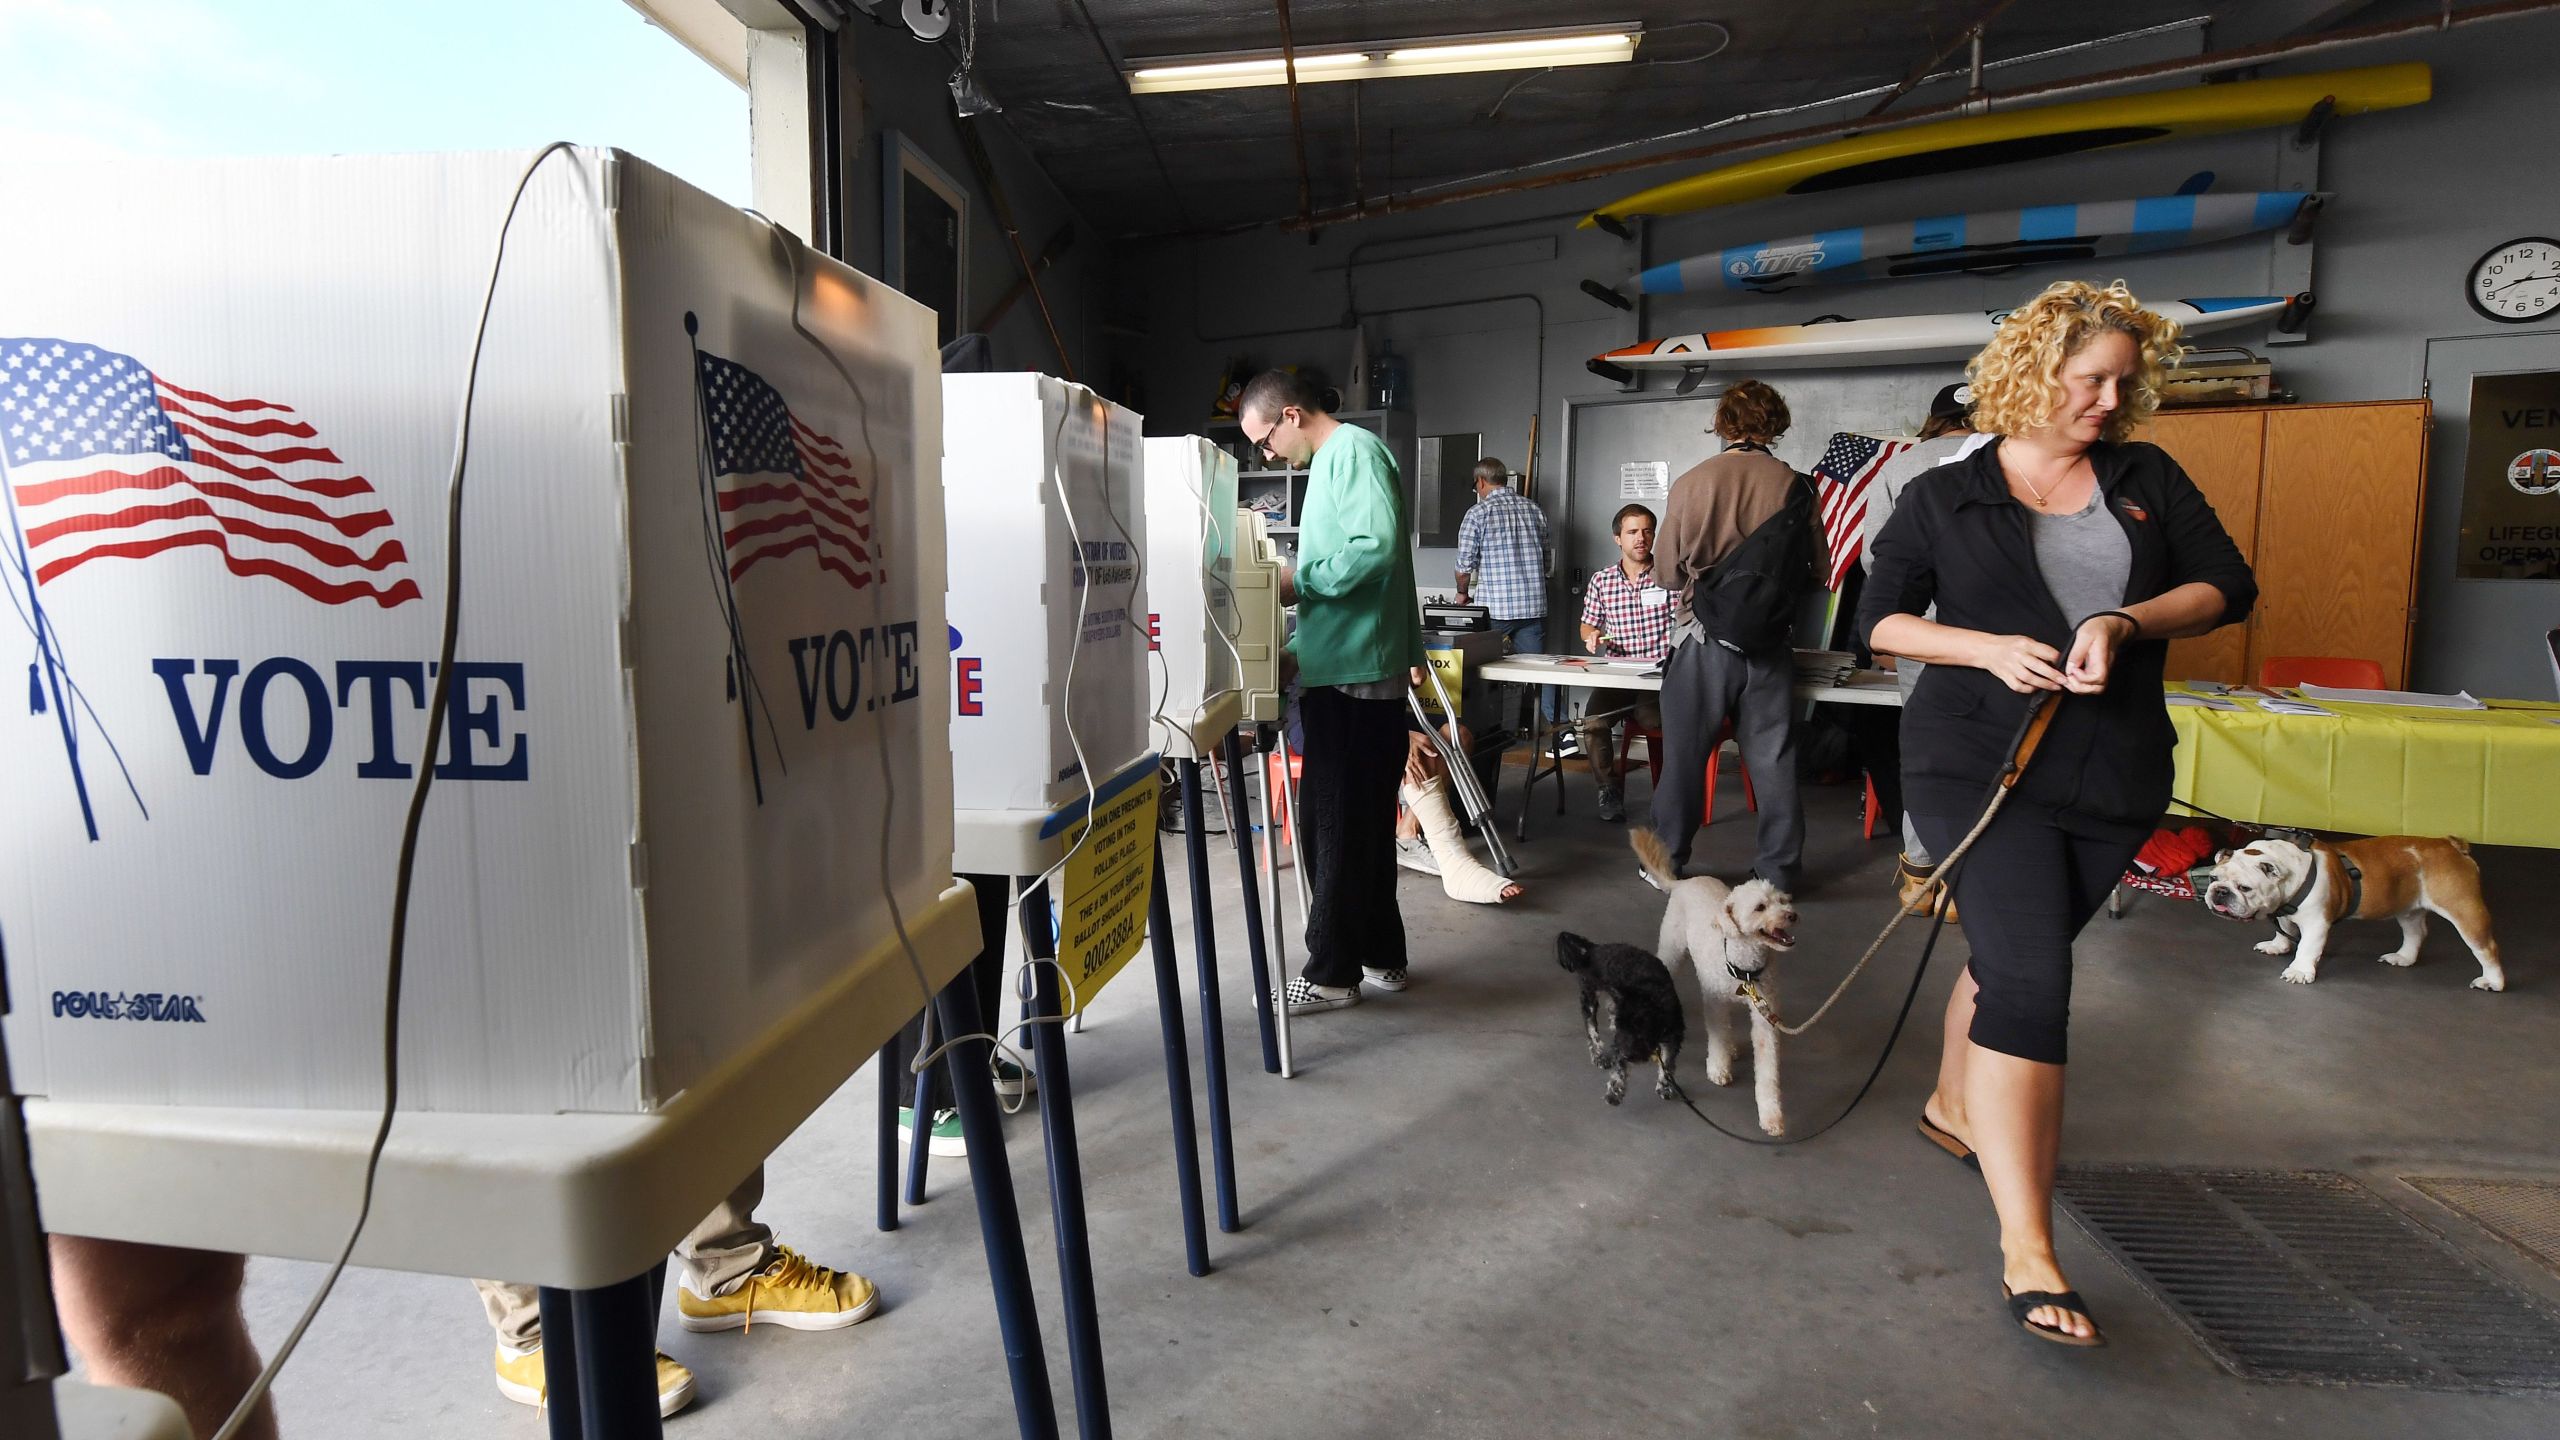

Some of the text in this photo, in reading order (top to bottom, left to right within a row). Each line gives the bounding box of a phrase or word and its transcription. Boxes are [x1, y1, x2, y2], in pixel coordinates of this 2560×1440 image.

[2504, 254, 2514, 264] 11
[2519, 249, 2533, 259] 12
[2542, 252, 2547, 261] 1
[2488, 265, 2503, 275] 10
[2482, 278, 2493, 287] 9
[2486, 291, 2496, 300] 8
[2548, 287, 2558, 296] 4
[2498, 300, 2507, 309] 7
[2515, 302, 2526, 312] 6
[2534, 297, 2544, 307] 5
[788, 621, 920, 731] VOTE
[152, 656, 530, 782] VOTE
[1092, 814, 1107, 834] THAN
[1108, 809, 1120, 824] ONE
[1121, 795, 1145, 820] PRECINCT
[1146, 789, 1152, 801] IS
[1093, 819, 1136, 856] VOTING IN THIS
[1093, 853, 1119, 879] POLLING
[1079, 903, 1093, 922] THE
[1099, 892, 1108, 906] ON
[1109, 878, 1125, 901] YOUR
[1126, 863, 1144, 887] SAMPLE
[1074, 920, 1100, 949] BALLOT
[1101, 900, 1123, 926] SHOULD
[1124, 884, 1140, 912] MATCH
[1083, 912, 1134, 979] 9002388A
